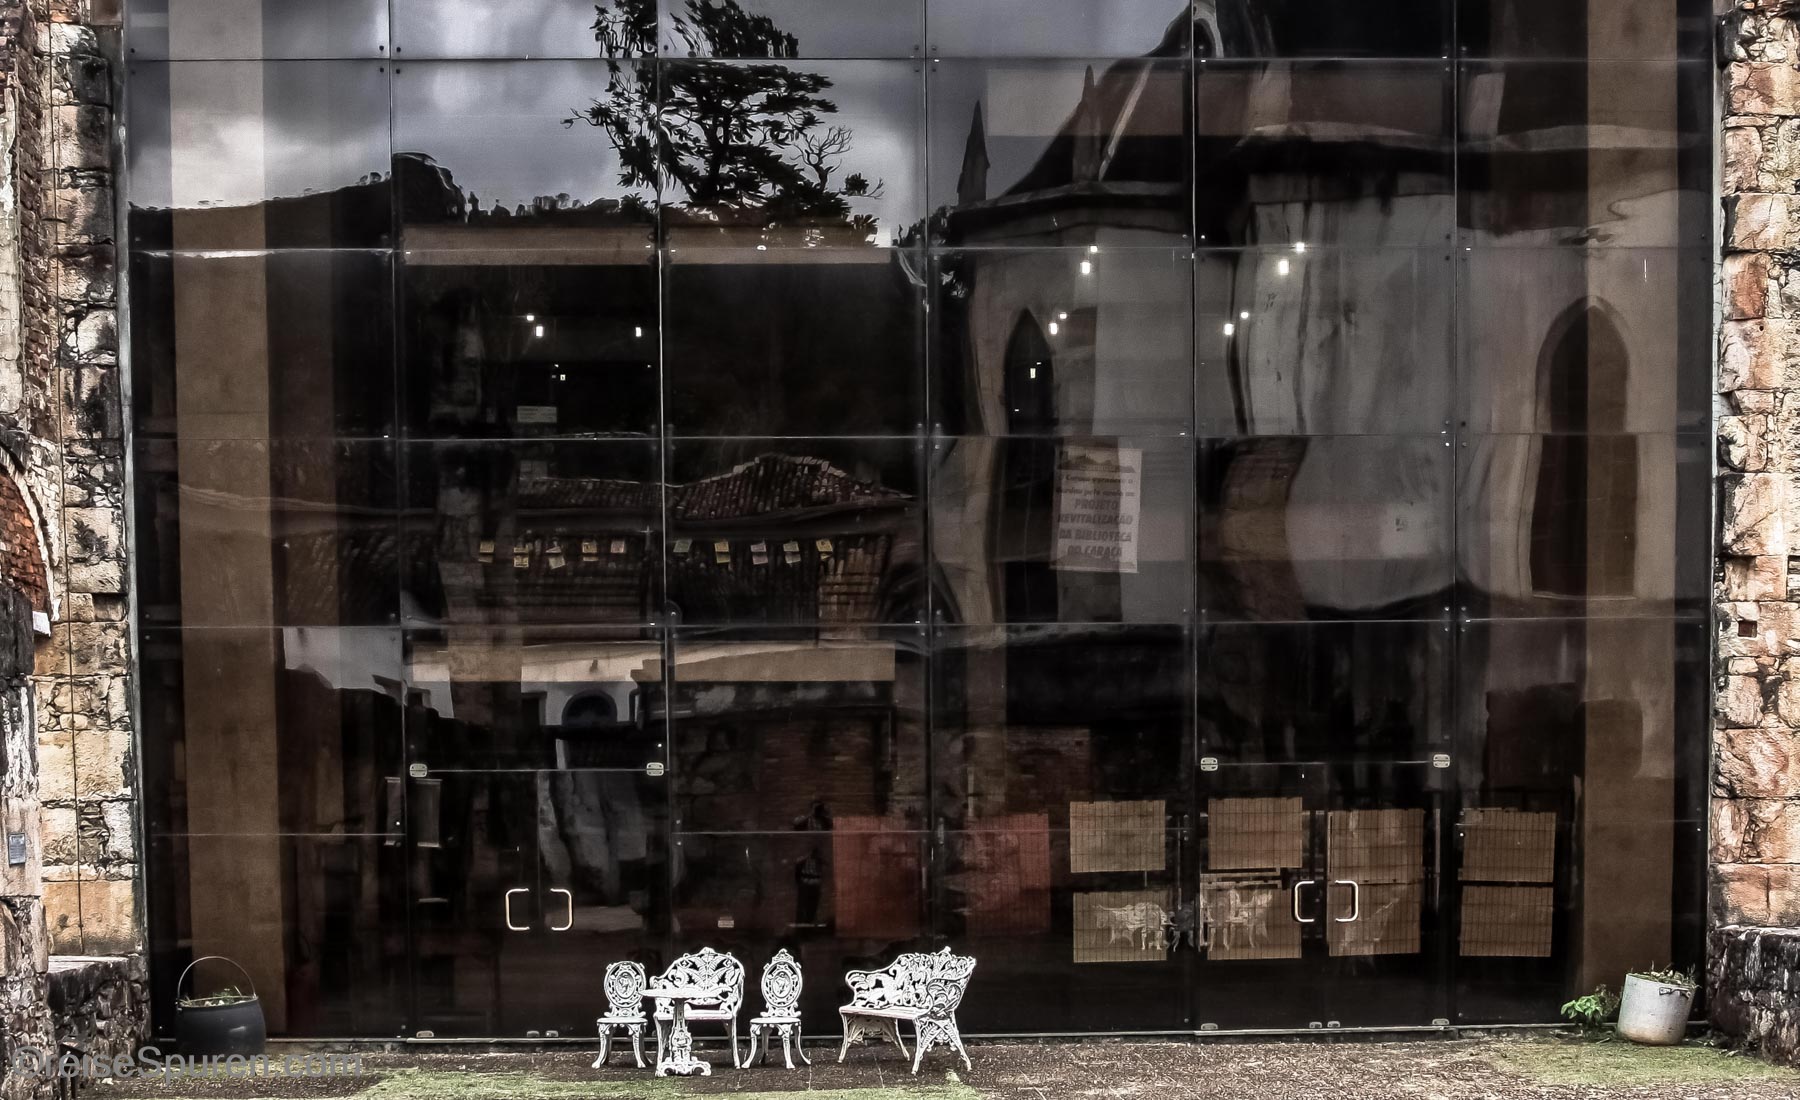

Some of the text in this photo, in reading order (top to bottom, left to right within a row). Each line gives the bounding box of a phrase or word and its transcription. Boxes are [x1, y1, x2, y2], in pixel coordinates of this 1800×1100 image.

[1074, 499, 1120, 510] PROJETO
[1059, 529, 1072, 539] DA
[1075, 530, 1132, 542] BIBLIOTECA
